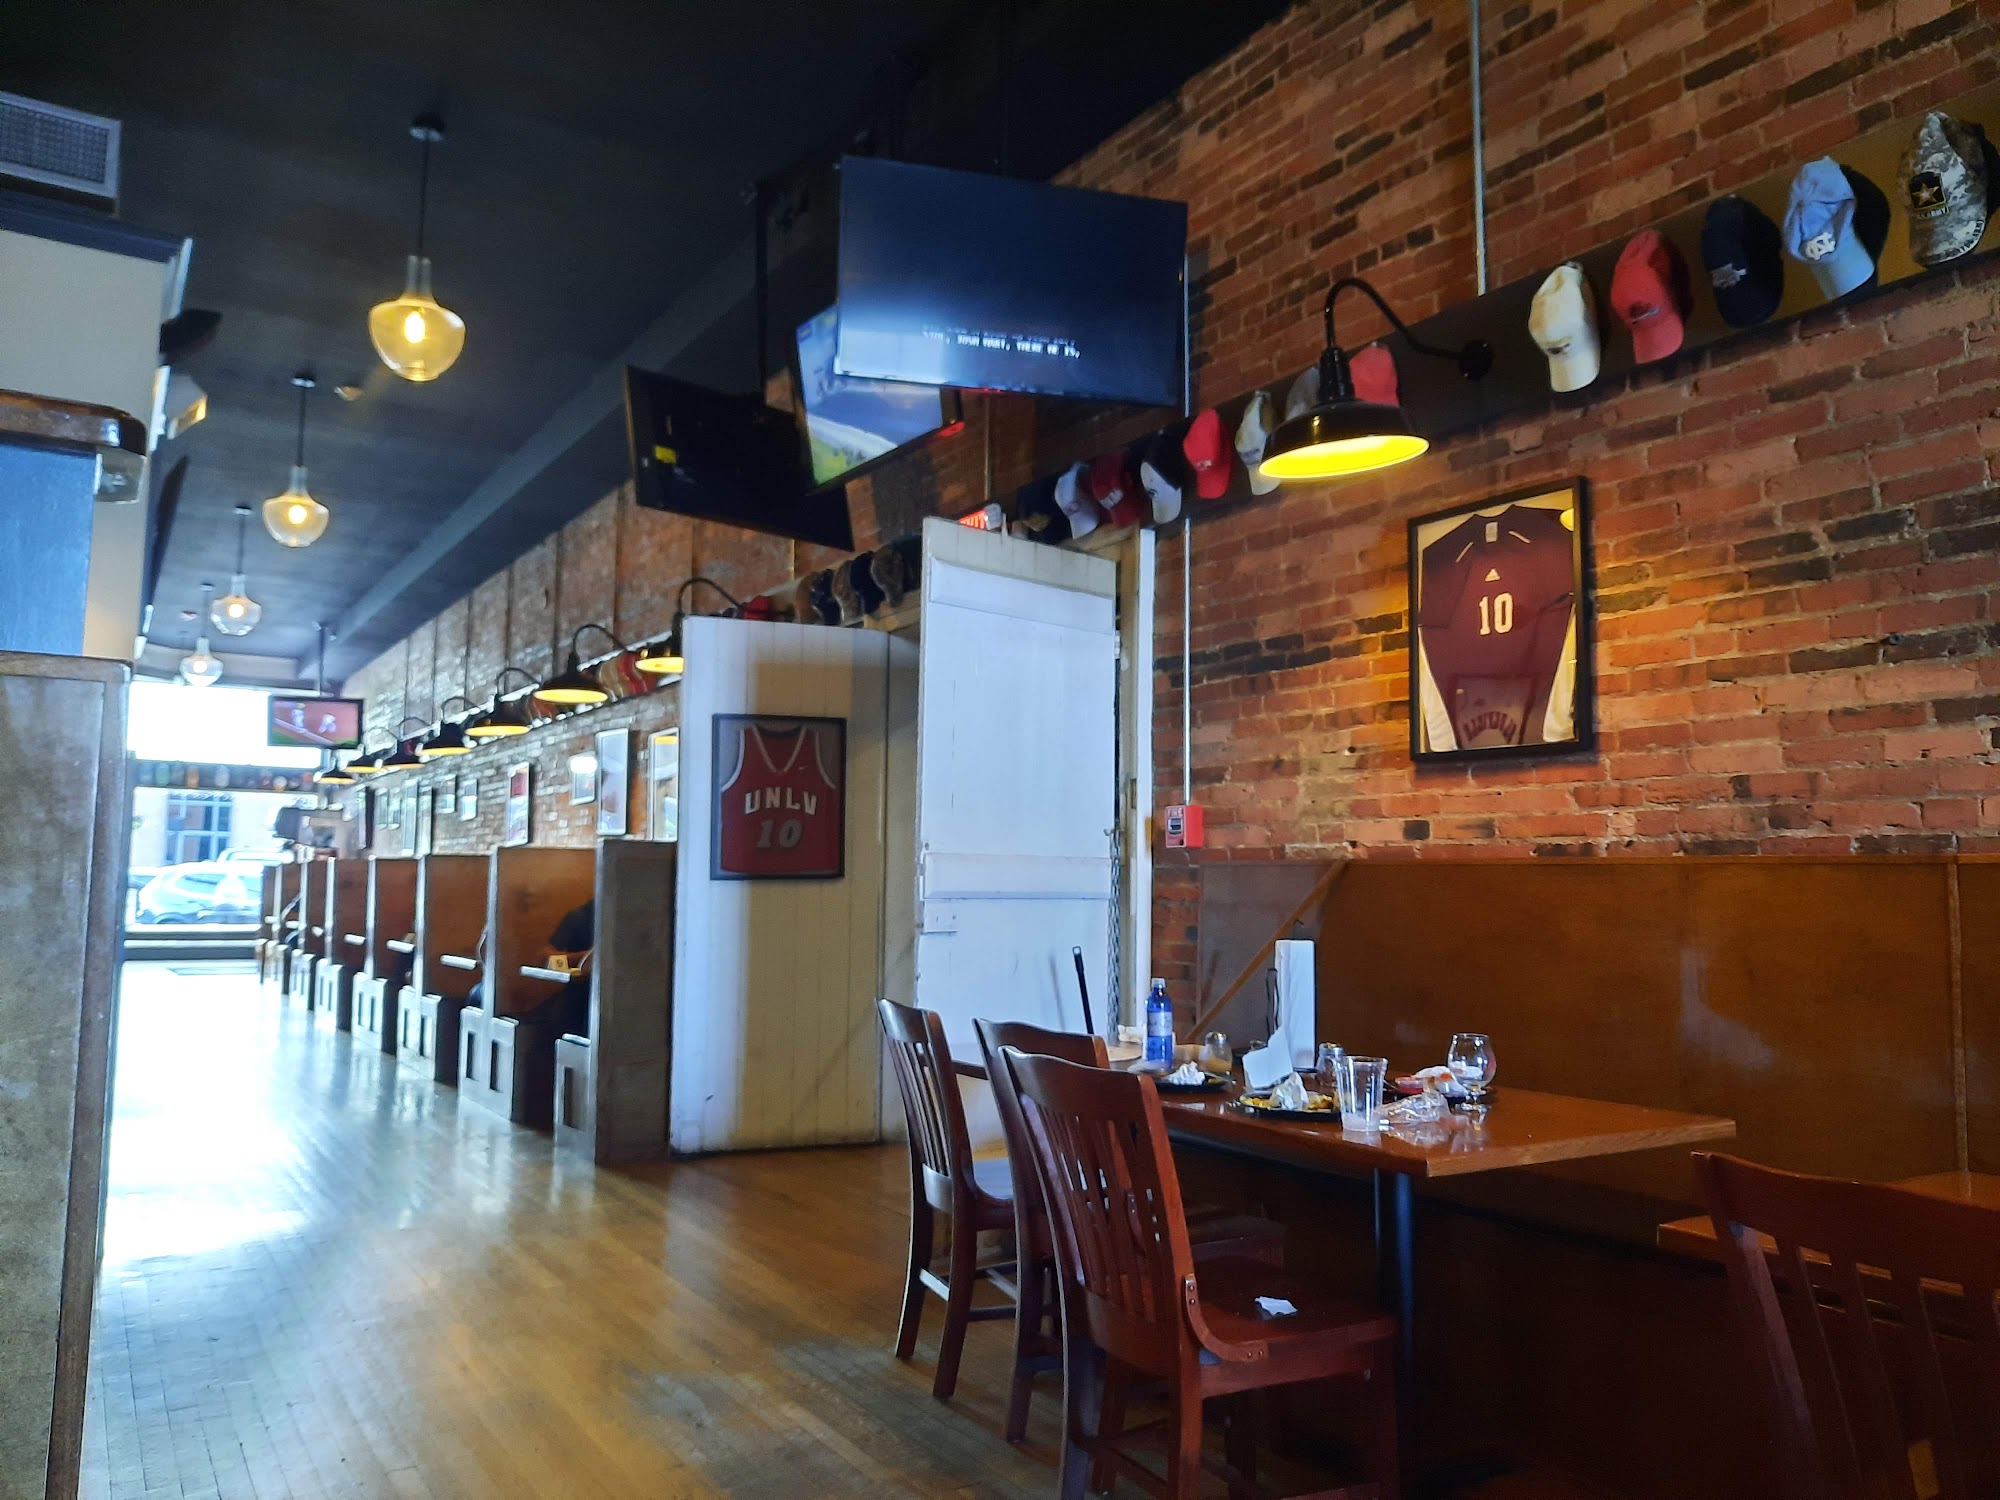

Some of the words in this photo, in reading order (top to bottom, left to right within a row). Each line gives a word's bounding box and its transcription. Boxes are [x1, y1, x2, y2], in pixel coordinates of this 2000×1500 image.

[1479, 592, 1514, 636] 10
[745, 787, 817, 815] UNLV
[1167, 808, 1184, 817] FIRE
[757, 819, 803, 848] 10
